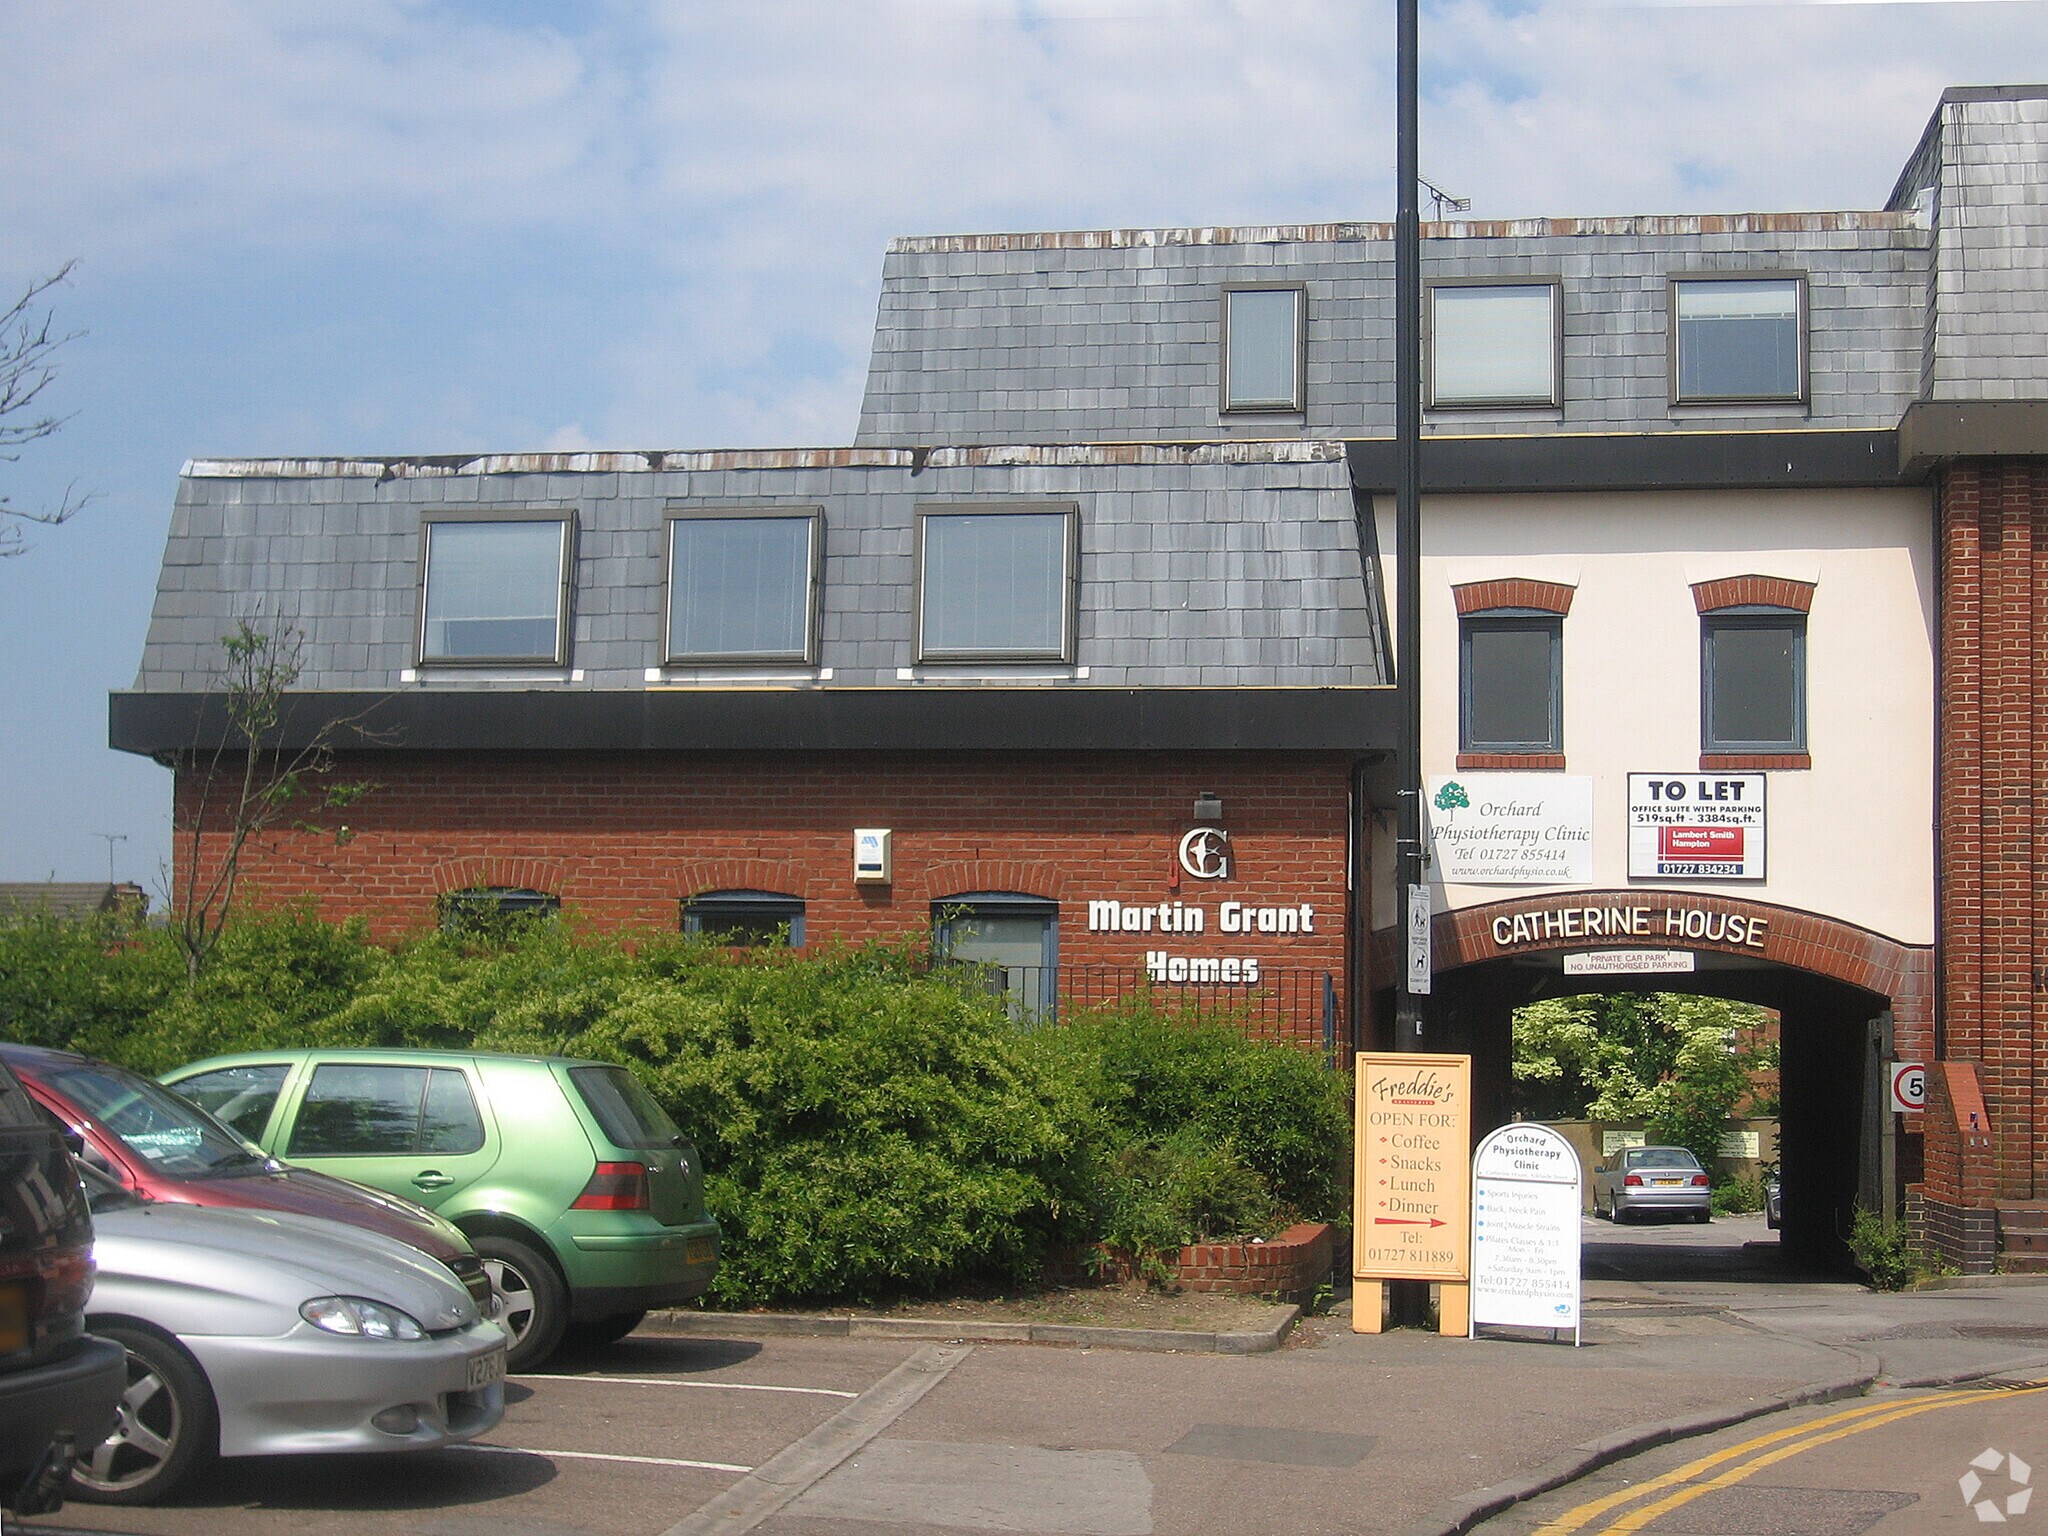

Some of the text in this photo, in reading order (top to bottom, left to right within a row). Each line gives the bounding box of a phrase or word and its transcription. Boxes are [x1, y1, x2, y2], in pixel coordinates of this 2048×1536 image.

[1648, 781, 1745, 800] TO LET
[1480, 800, 1544, 817] Orchard
[1631, 805, 1762, 813] OFFICE SUITE WITH PARKING
[1697, 813, 1756, 825] 3384sq.ft.
[1431, 823, 1590, 846] Physiotherapy Clinic
[1672, 830, 1735, 839] Lambert Smith
[1672, 840, 1711, 848] Hampton
[1454, 847, 1566, 861] Tel 01727 855414
[1452, 865, 1572, 879] www.orchardphysio.co.uk
[1663, 864, 1737, 874] 01727 834234
[1088, 899, 1313, 933] Martin Grant
[1492, 906, 1768, 948] CATHERINE HOUSE
[1590, 953, 1667, 963] PRIVATE CAR PARK
[1145, 951, 1259, 982] Homes
[1570, 961, 1688, 971] NO UNAUTHORISED PARKING
[1371, 1070, 1454, 1103] Freddie's
[1909, 1077, 1923, 1096] 5
[1370, 1112, 1456, 1128] OPEN FOR:
[1391, 1133, 1441, 1150] Coffee
[1506, 1134, 1546, 1146] Orchard
[1493, 1145, 1561, 1160] Physiotherapy
[1390, 1154, 1442, 1172] Snacks
[1514, 1160, 1539, 1170] Clinic
[1390, 1176, 1435, 1192] Lunch
[1487, 1190, 1538, 1200] Sports Injuries
[1389, 1197, 1439, 1214] Dinner
[1487, 1204, 1546, 1215] Back, Neck Pain
[1508, 1222, 1534, 1230] Muscle
[1535, 1223, 1560, 1232] Strains
[1401, 1231, 1423, 1244] Tel:
[1485, 1235, 1509, 1244] Pilates
[1510, 1236, 1537, 1246] Classes
[1368, 1248, 1454, 1263] 01727 811889
[1534, 1246, 1544, 1254] Fri
[1531, 1278, 1570, 1289] 855414
